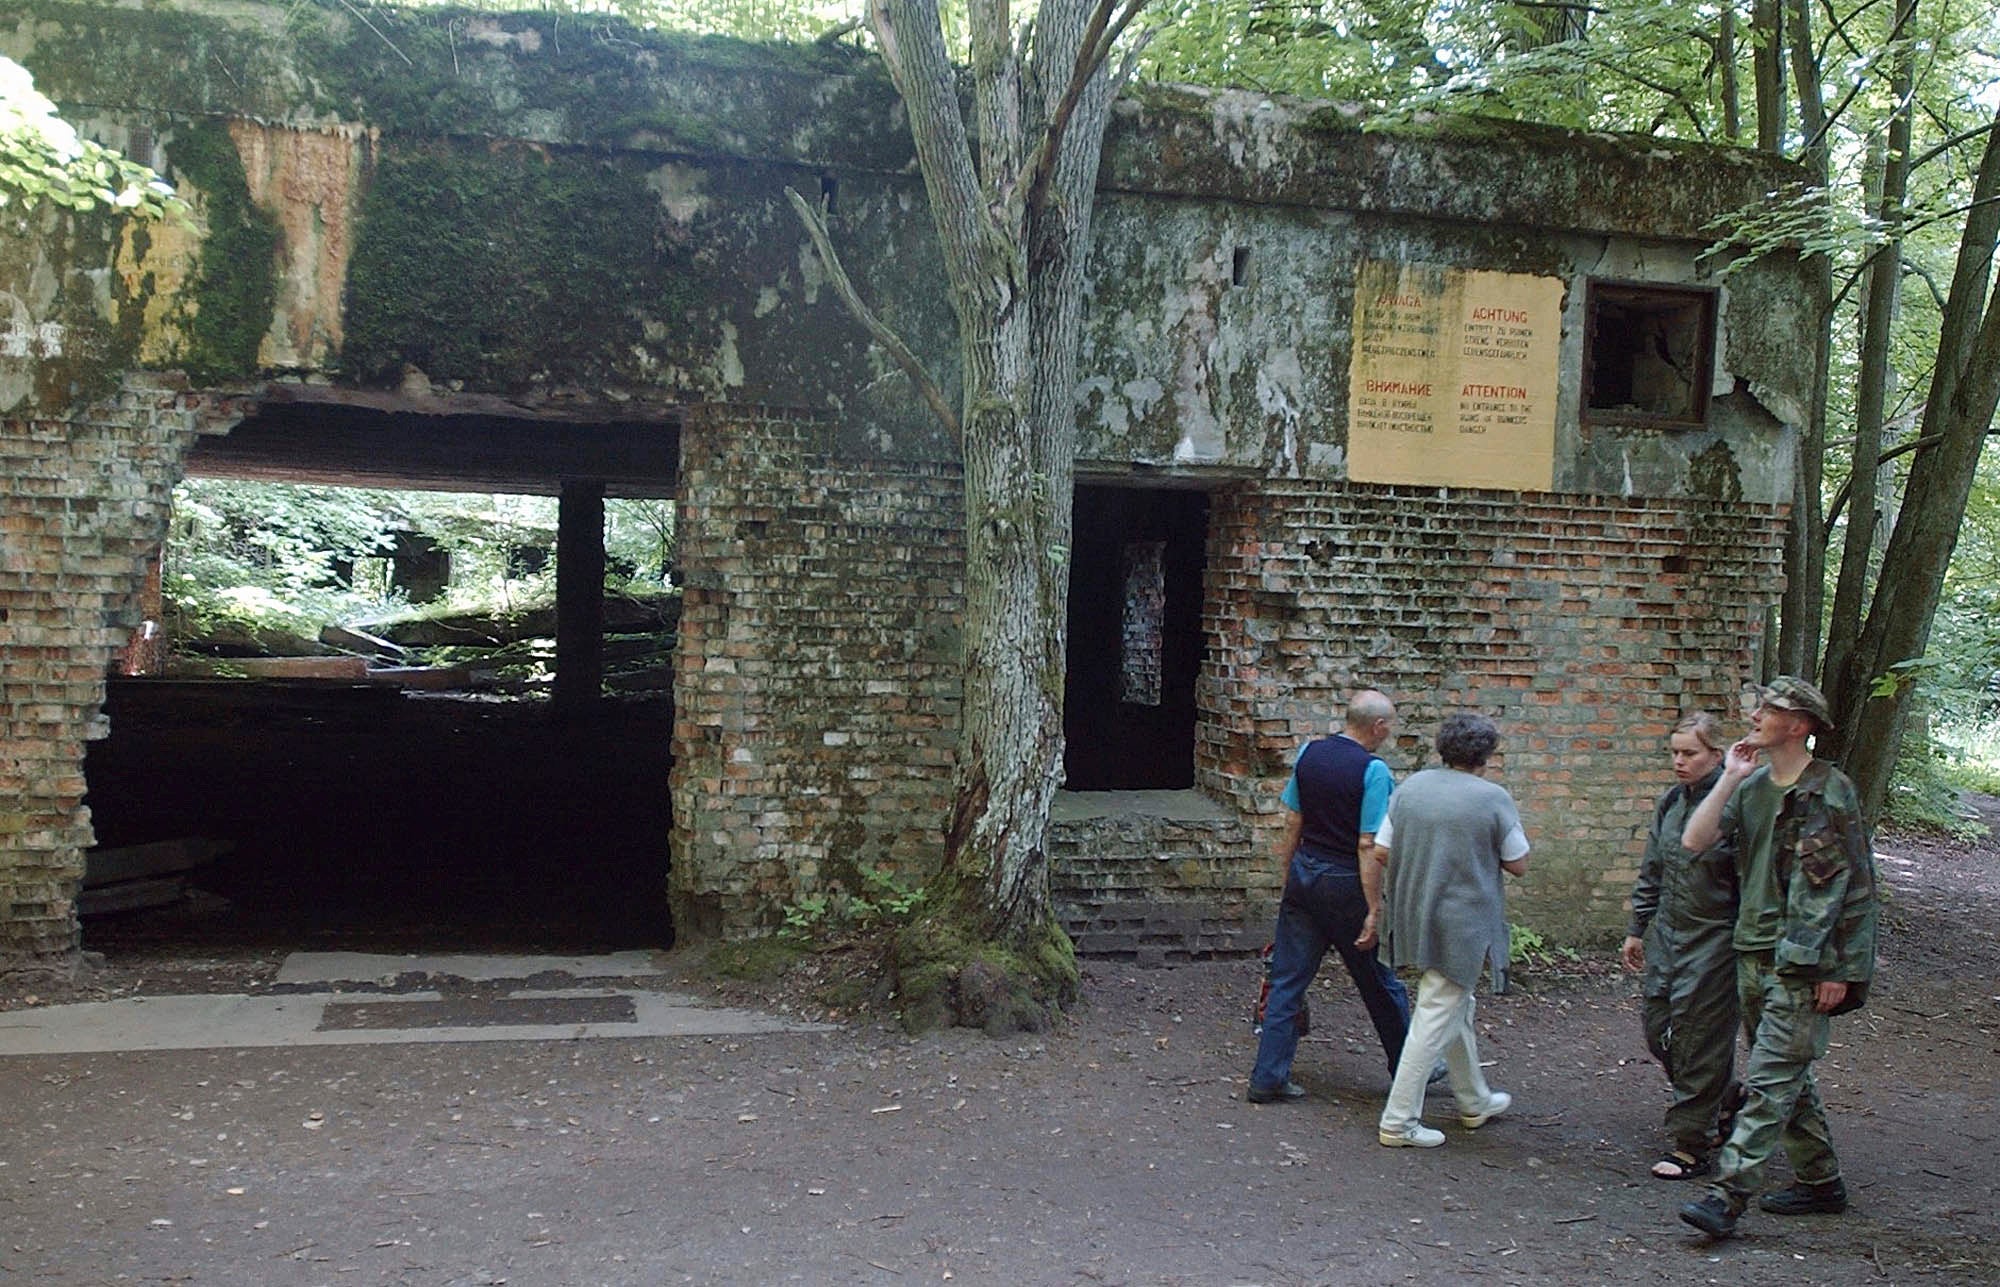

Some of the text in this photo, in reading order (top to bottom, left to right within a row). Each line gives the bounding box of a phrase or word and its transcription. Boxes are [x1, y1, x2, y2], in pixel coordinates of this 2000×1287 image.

[1472, 306, 1528, 324] ACHTUNG
[1366, 379, 1433, 397] ВНИМАНИЕ
[1462, 384, 1527, 399] ATTENTION
